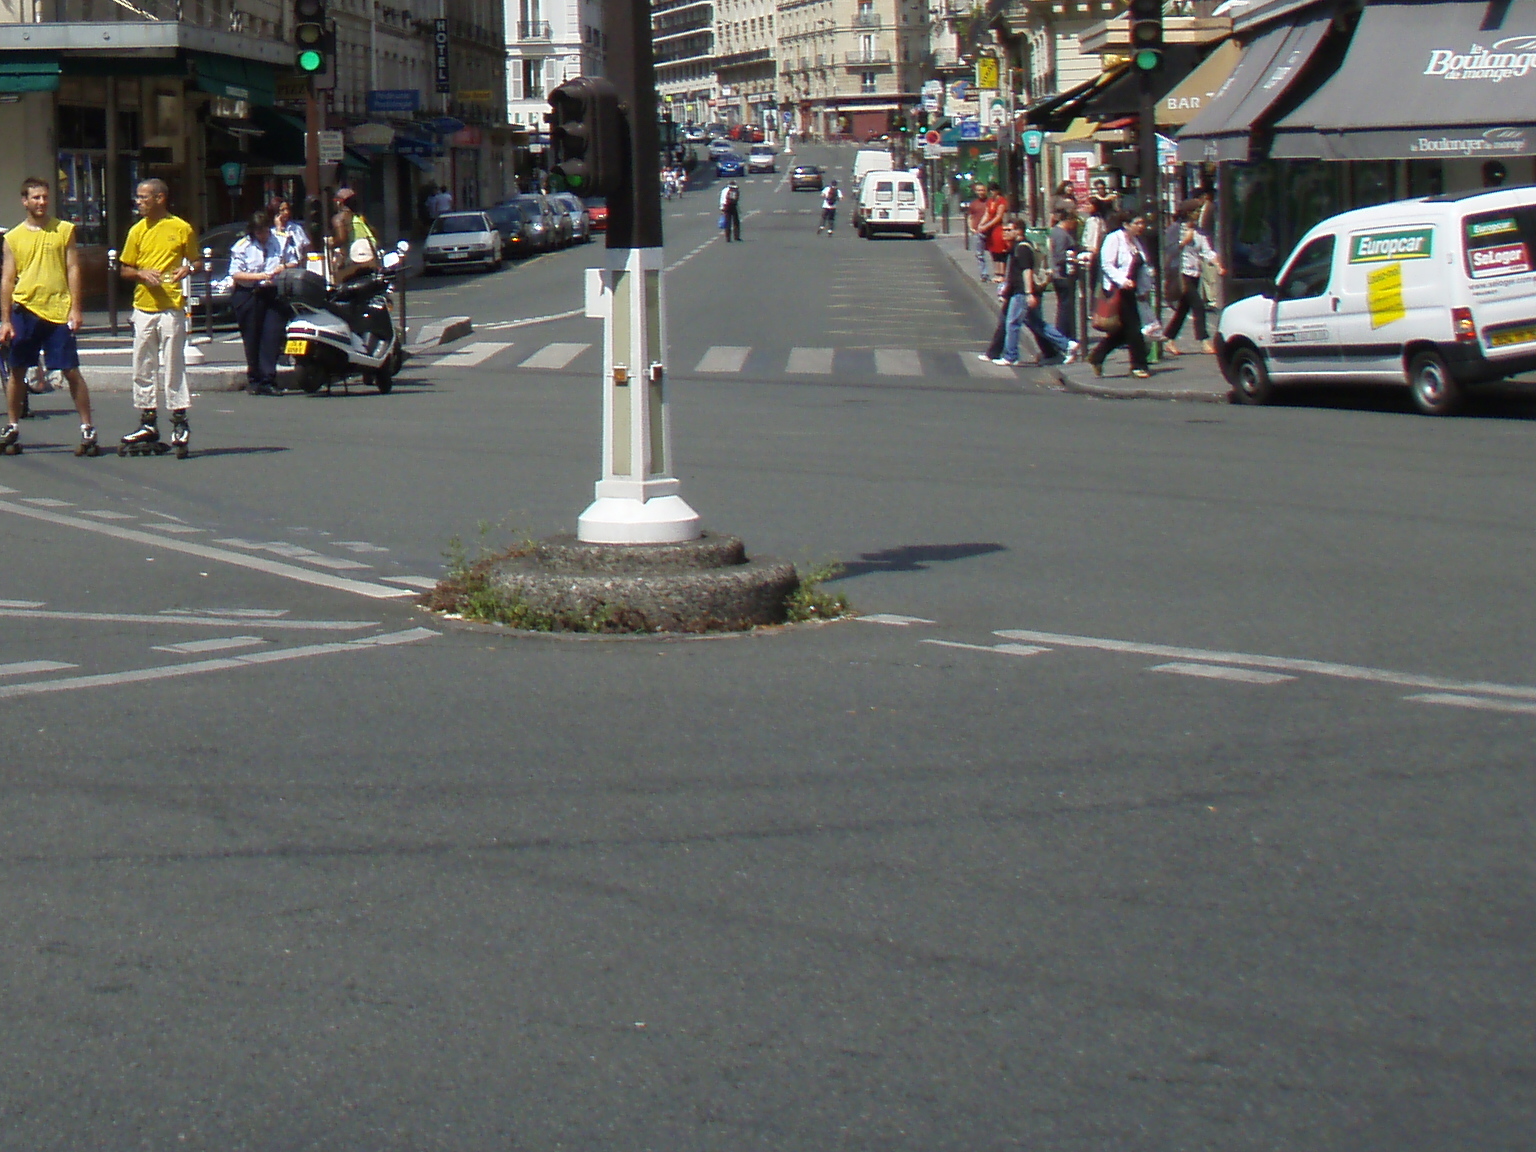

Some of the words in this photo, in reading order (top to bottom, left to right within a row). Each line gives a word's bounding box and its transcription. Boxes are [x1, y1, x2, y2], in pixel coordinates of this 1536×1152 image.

[435, 20, 447, 79] HOTEL
[1167, 97, 1201, 110] BAR
[1418, 137, 1485, 155] Boulanger
[1474, 221, 1512, 234] Europcar
[1357, 235, 1424, 259] Europcar
[1473, 248, 1522, 266] SeLoger
